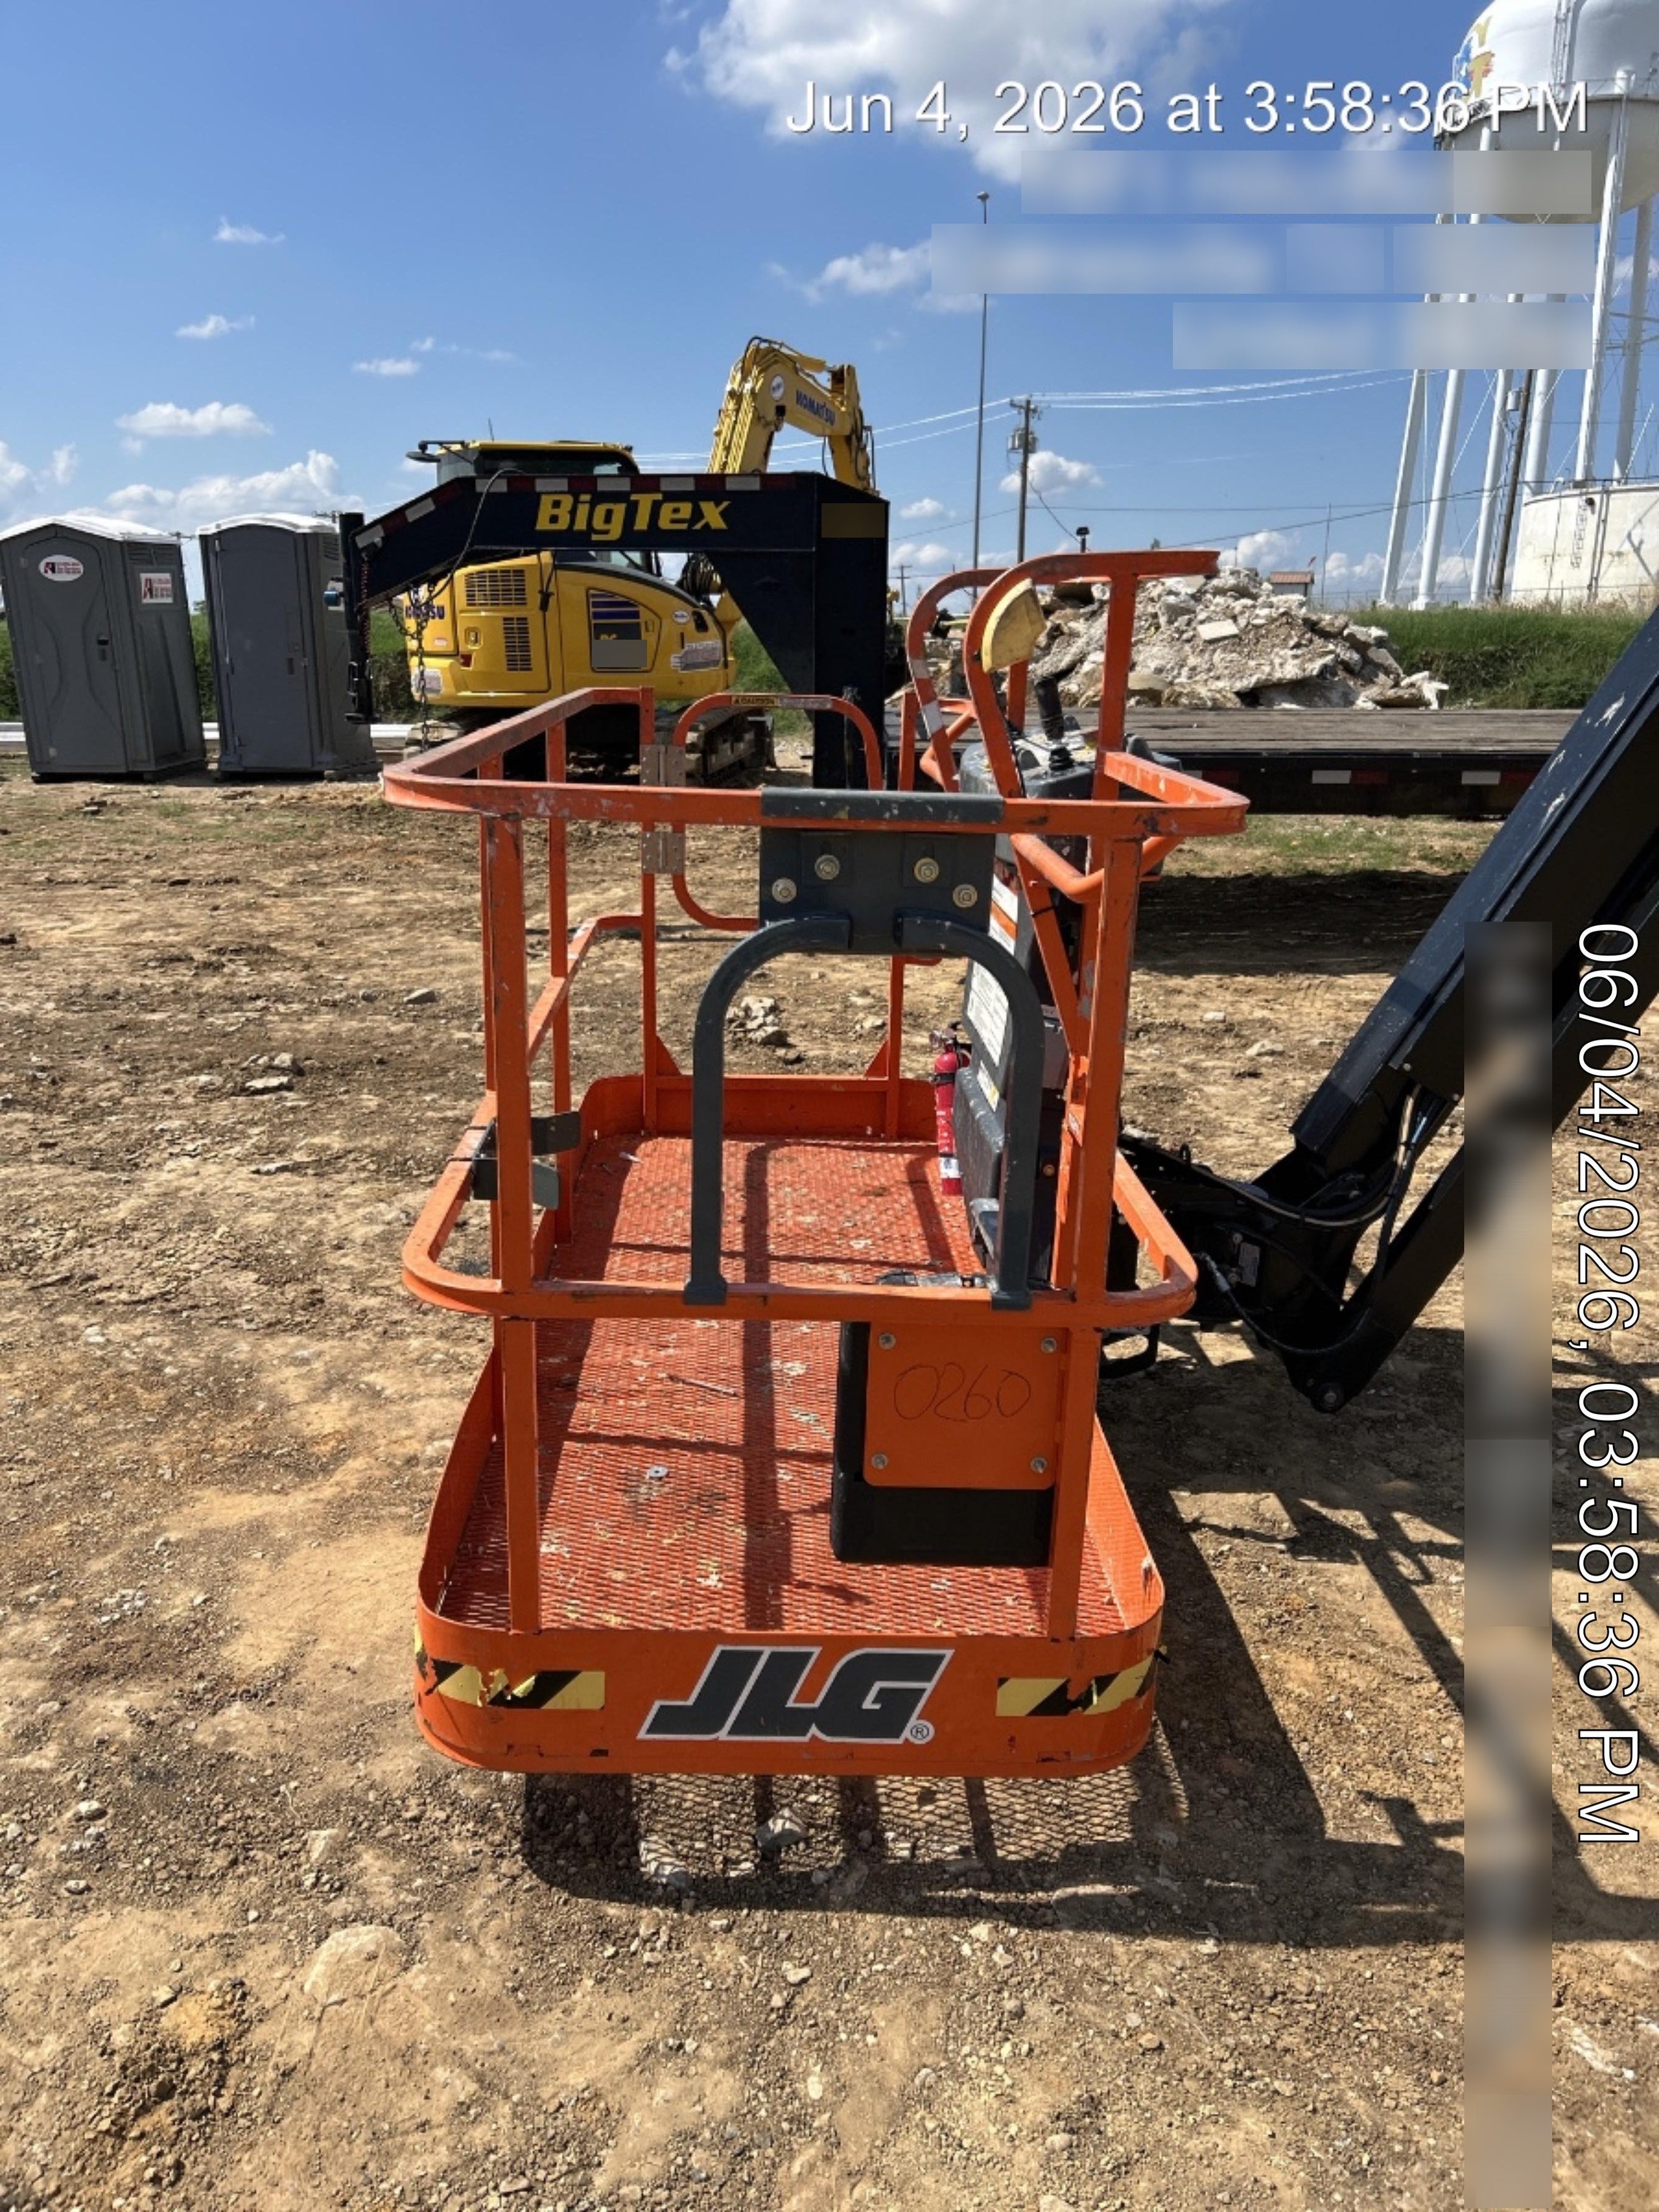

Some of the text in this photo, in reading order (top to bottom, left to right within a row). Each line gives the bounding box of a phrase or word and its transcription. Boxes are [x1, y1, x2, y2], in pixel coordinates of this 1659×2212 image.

[796, 389, 836, 426] KOMATSU
[535, 493, 731, 541] BigTex
[893, 1362, 1031, 1423] 0260
